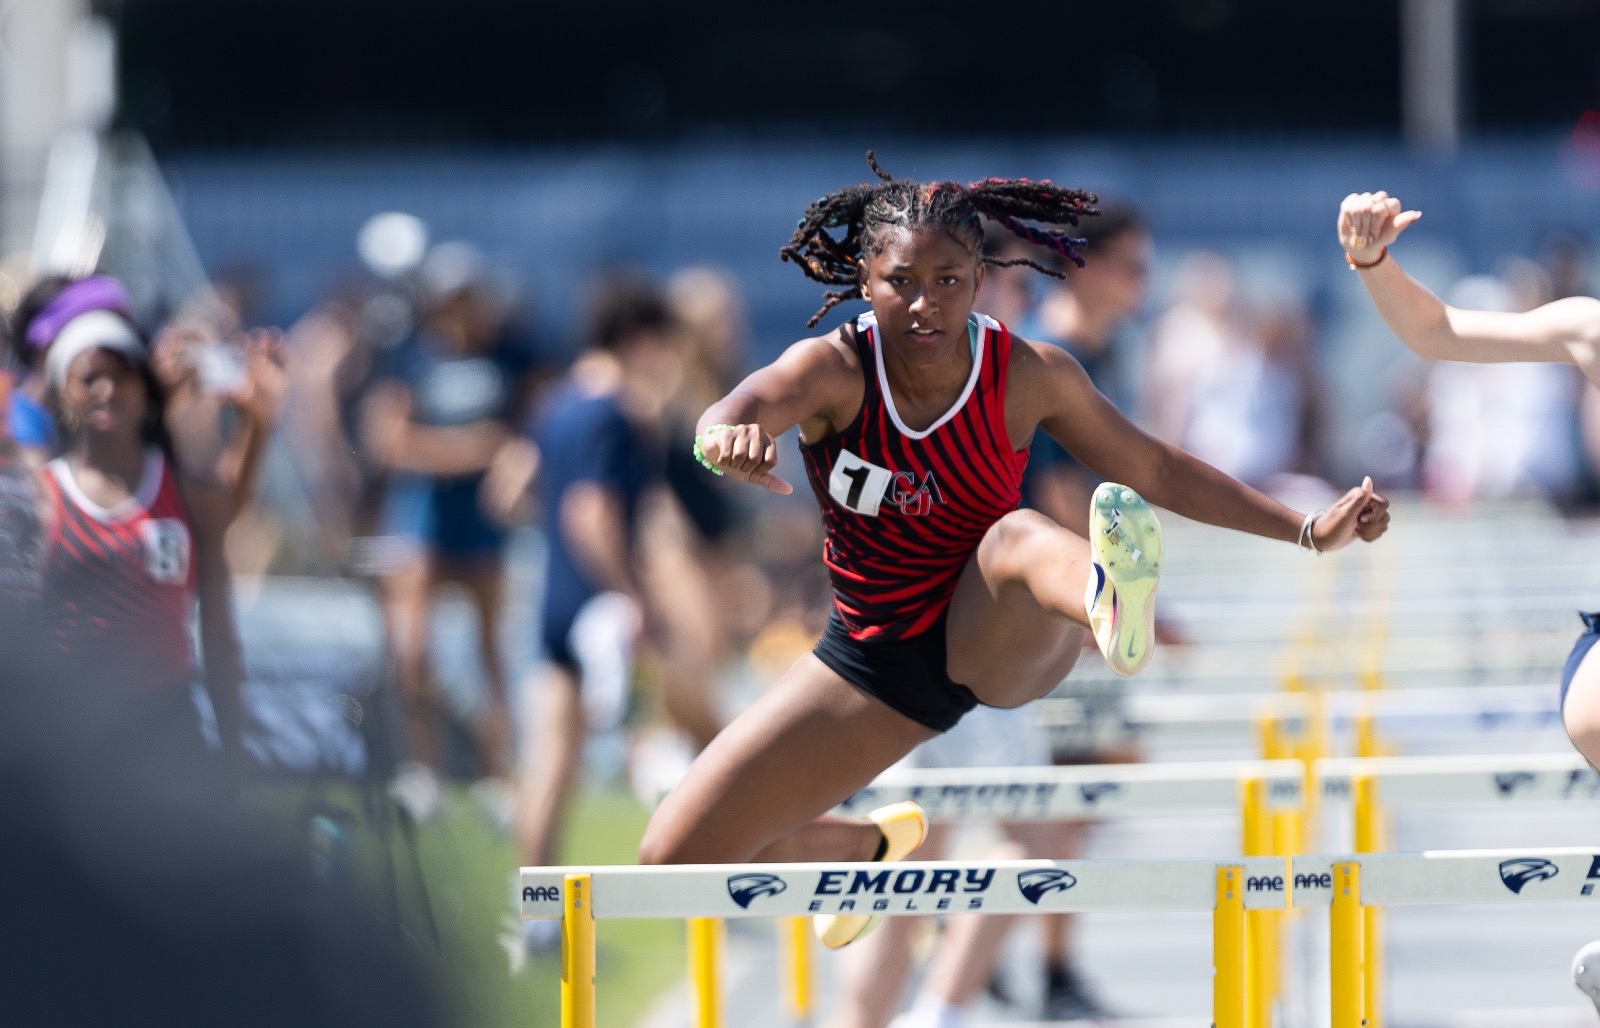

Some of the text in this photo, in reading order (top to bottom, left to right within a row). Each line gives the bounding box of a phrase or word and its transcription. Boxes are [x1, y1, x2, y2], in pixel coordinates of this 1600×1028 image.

[842, 465, 871, 511] 1
[814, 868, 997, 895] EMORY
[808, 898, 984, 912] EAGLES
